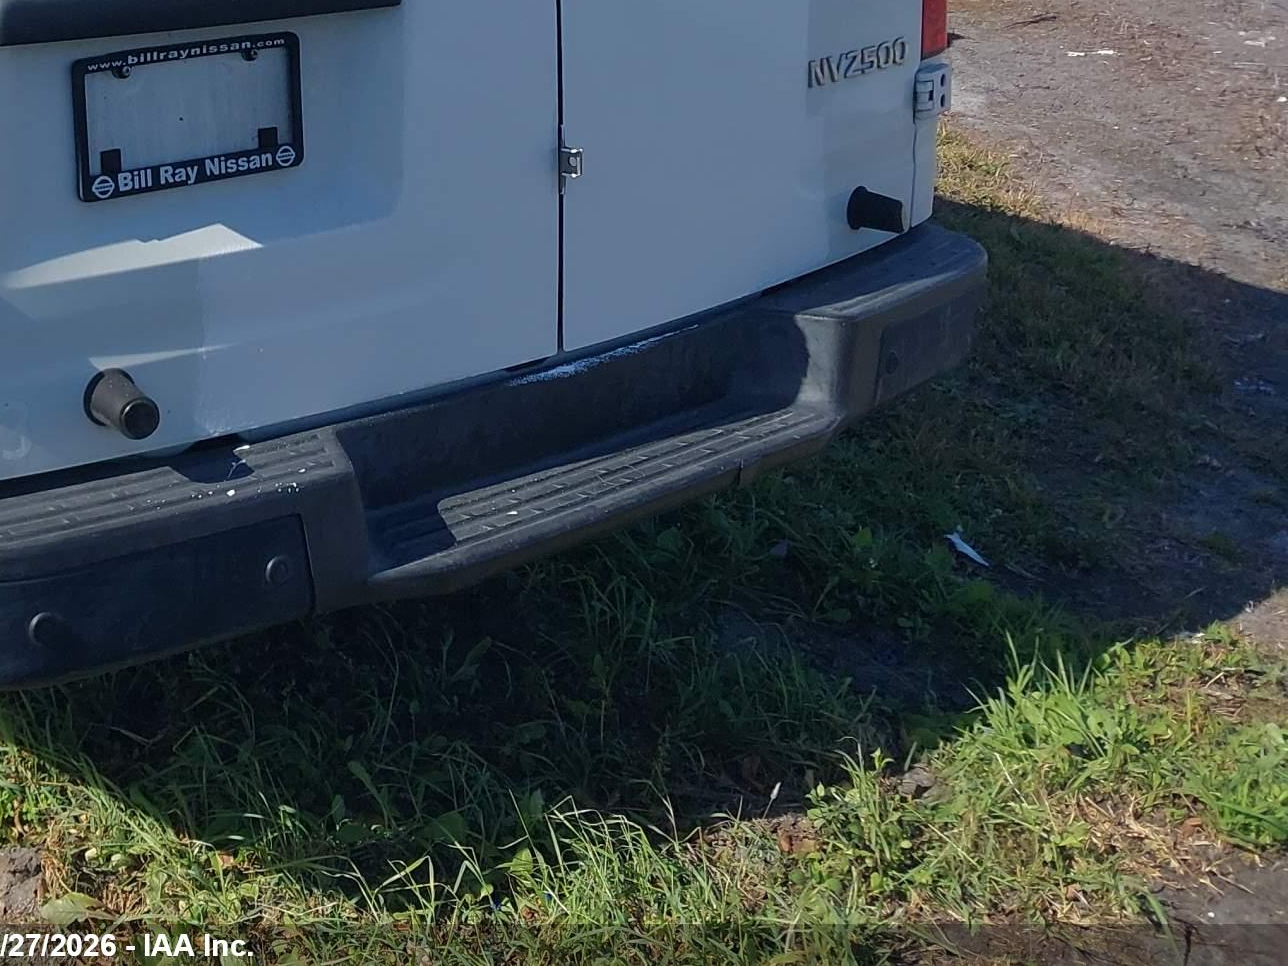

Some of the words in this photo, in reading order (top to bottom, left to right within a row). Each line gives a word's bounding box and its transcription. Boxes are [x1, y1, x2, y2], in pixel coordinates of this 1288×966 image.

[87, 37, 285, 72] www.billraynissan.com
[807, 36, 907, 89] NV2500
[117, 168, 152, 192] Bill
[159, 163, 198, 185] Ray
[205, 152, 273, 176] Nissan
